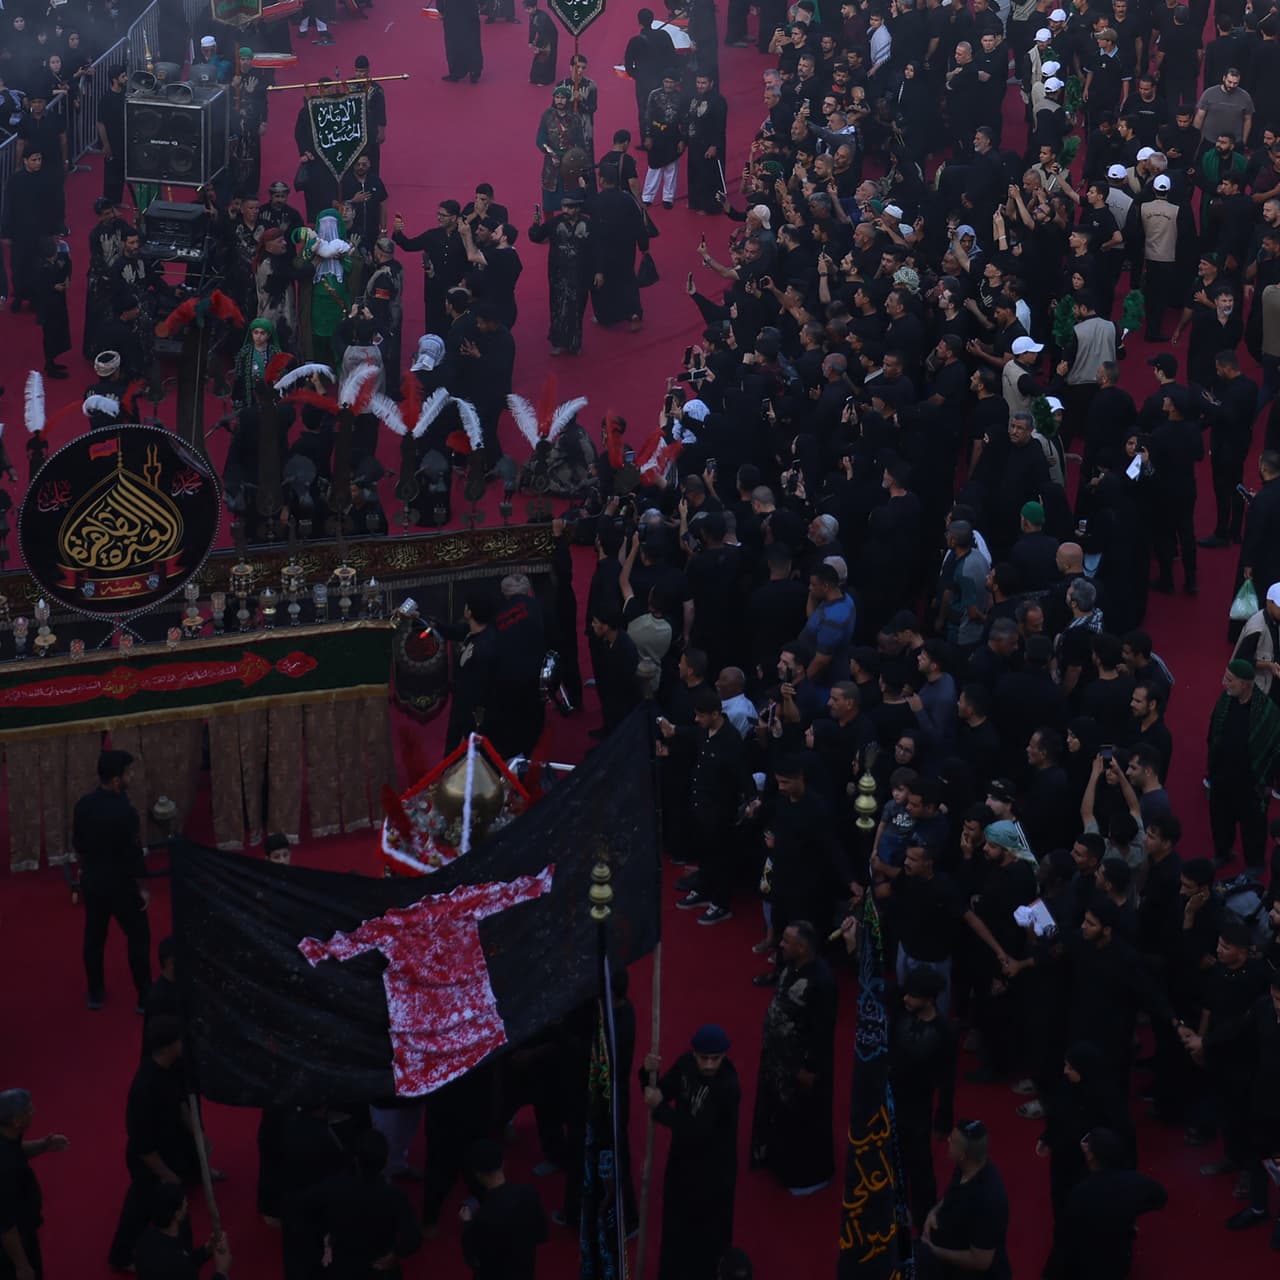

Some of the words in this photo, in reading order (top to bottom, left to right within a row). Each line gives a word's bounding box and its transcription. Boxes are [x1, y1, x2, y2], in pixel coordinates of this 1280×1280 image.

[573, 10, 580, 20] ع
[319, 123, 361, 148] الحسين
[336, 151, 344, 161] ع
[100, 581, 142, 595] هيئة
